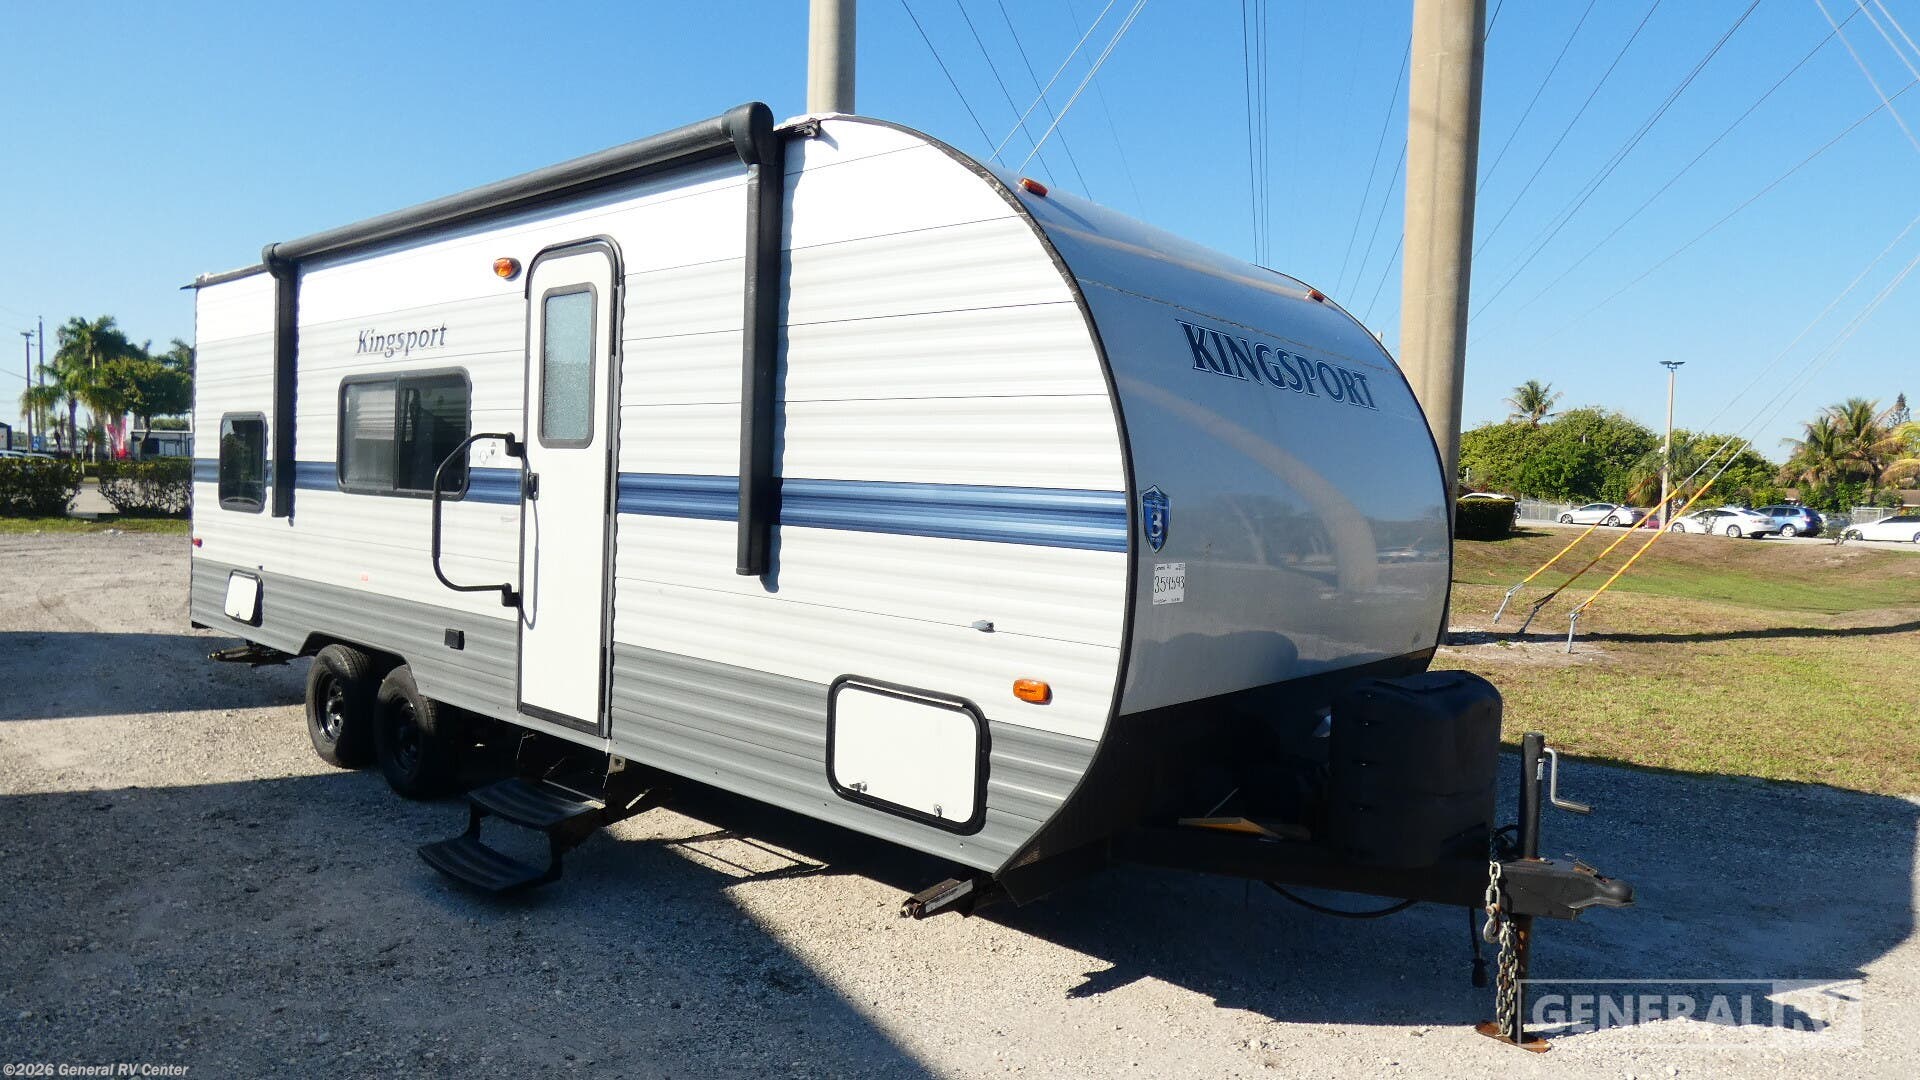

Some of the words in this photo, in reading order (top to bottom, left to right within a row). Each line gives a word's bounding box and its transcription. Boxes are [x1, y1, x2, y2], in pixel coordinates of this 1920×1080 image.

[356, 321, 447, 358] Kingsport
[1175, 319, 1379, 411] KINGSPORT
[1151, 512, 1163, 537] 3
